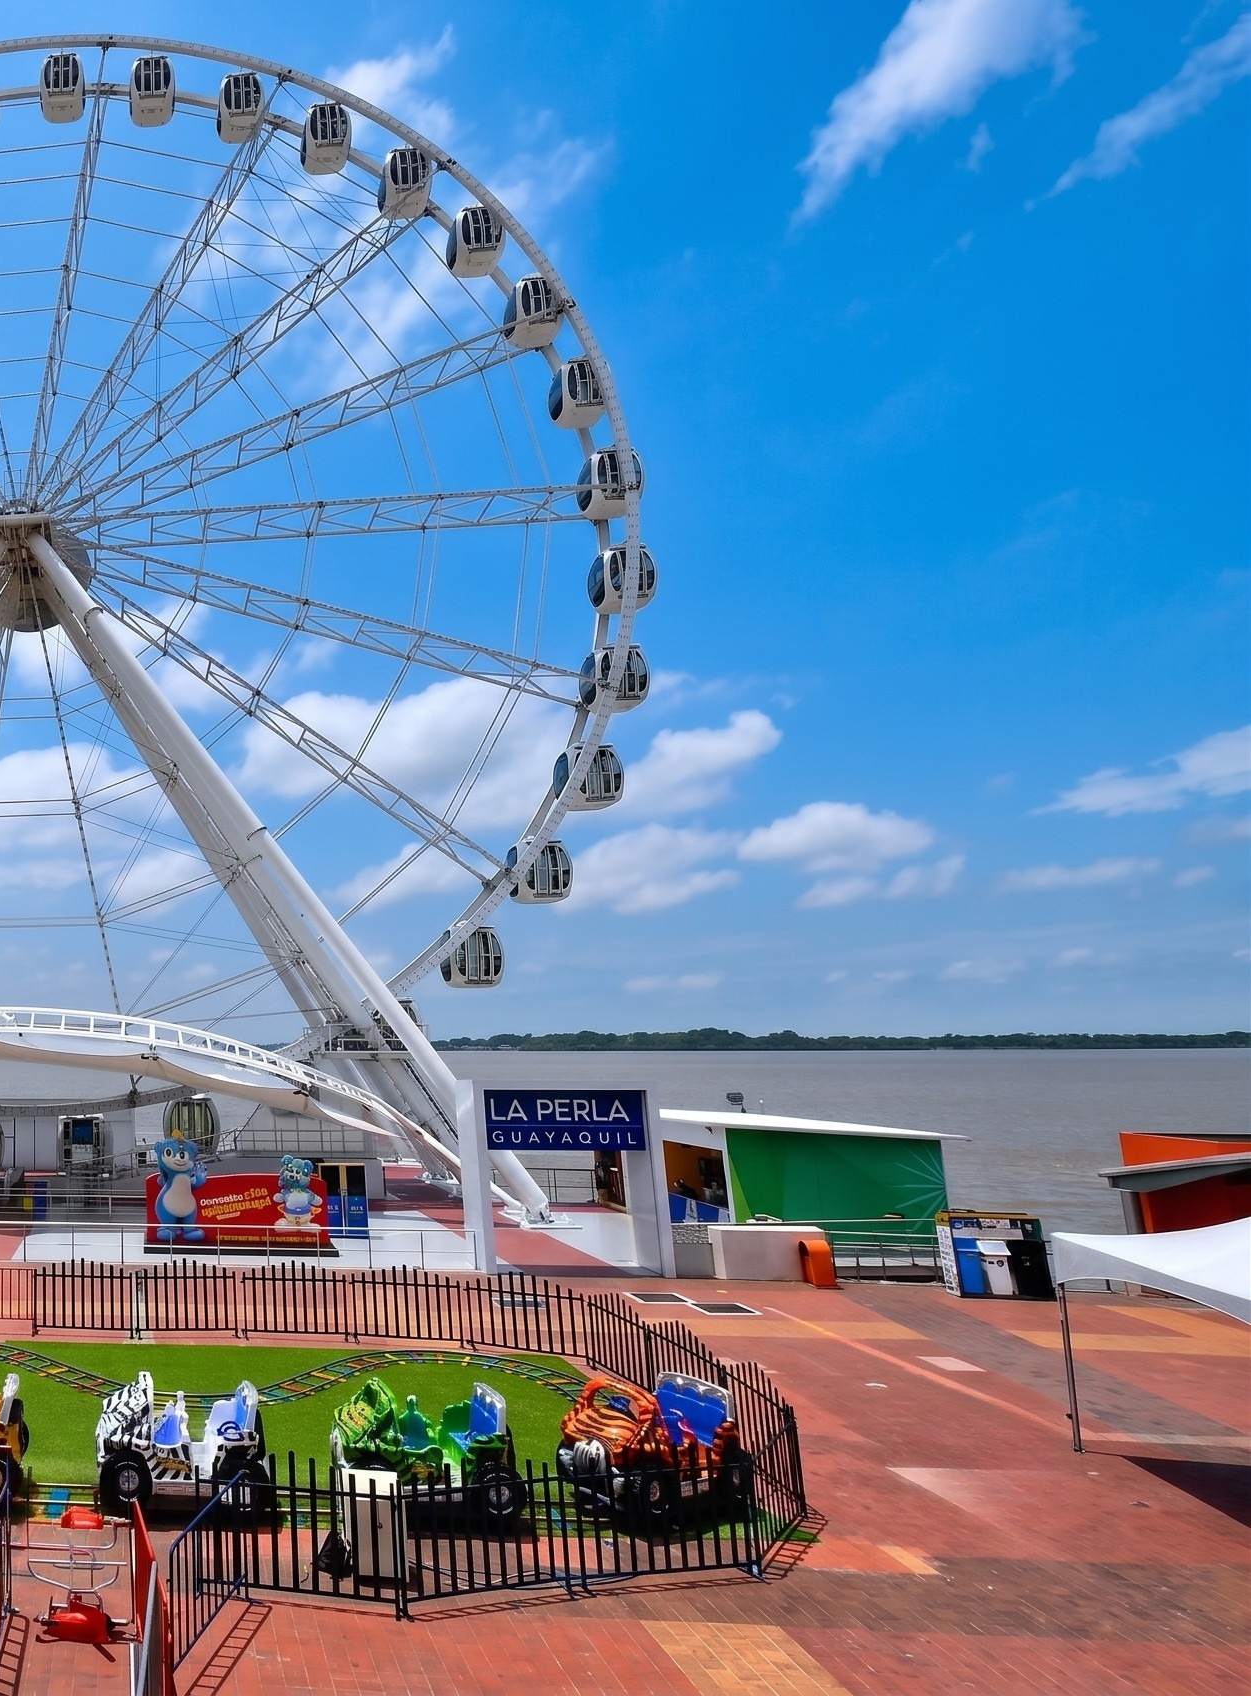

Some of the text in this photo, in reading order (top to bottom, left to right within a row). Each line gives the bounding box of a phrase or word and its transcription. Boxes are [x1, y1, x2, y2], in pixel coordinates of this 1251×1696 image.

[490, 1098, 630, 1122] LA PERLA
[492, 1131, 637, 1144] GUAYAQUIL
